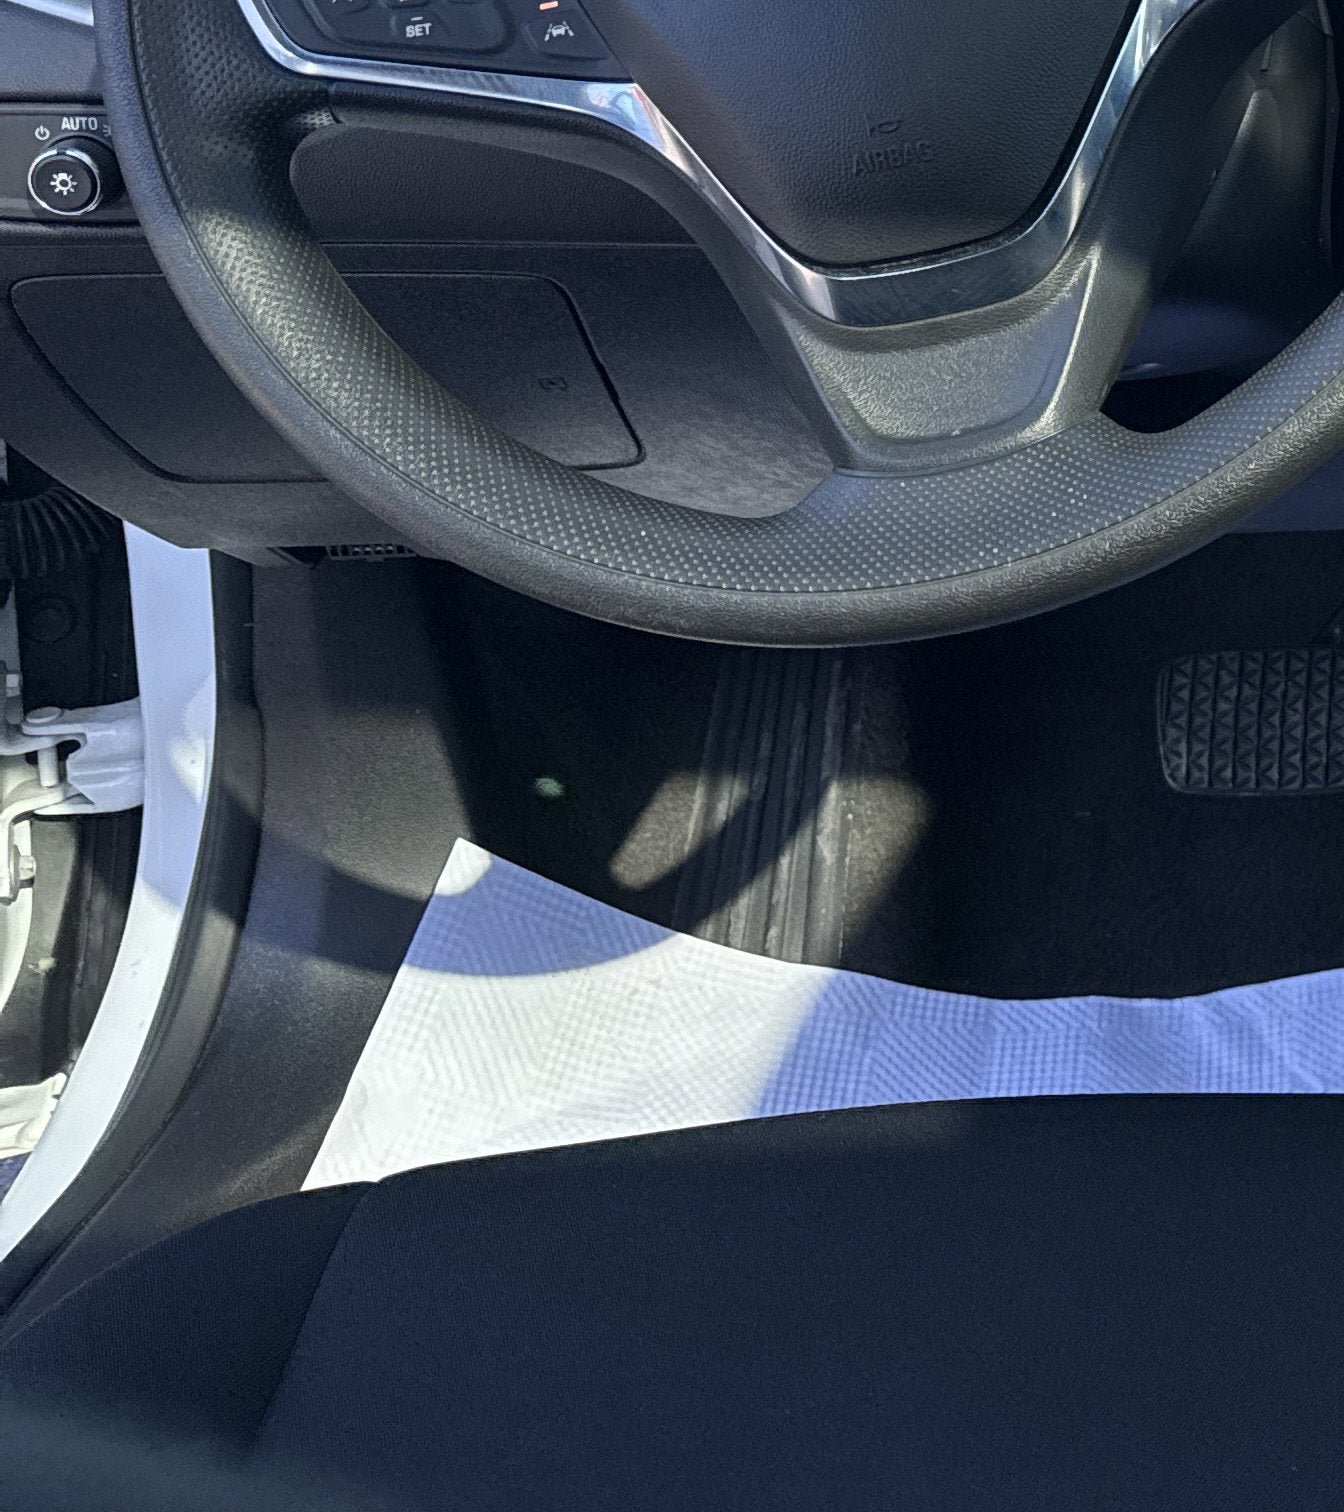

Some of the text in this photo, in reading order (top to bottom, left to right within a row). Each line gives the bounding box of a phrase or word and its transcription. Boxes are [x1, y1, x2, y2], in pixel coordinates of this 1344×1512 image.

[405, 22, 433, 38] SET
[61, 116, 98, 131] AUTO
[852, 140, 933, 178] AIRBAG
